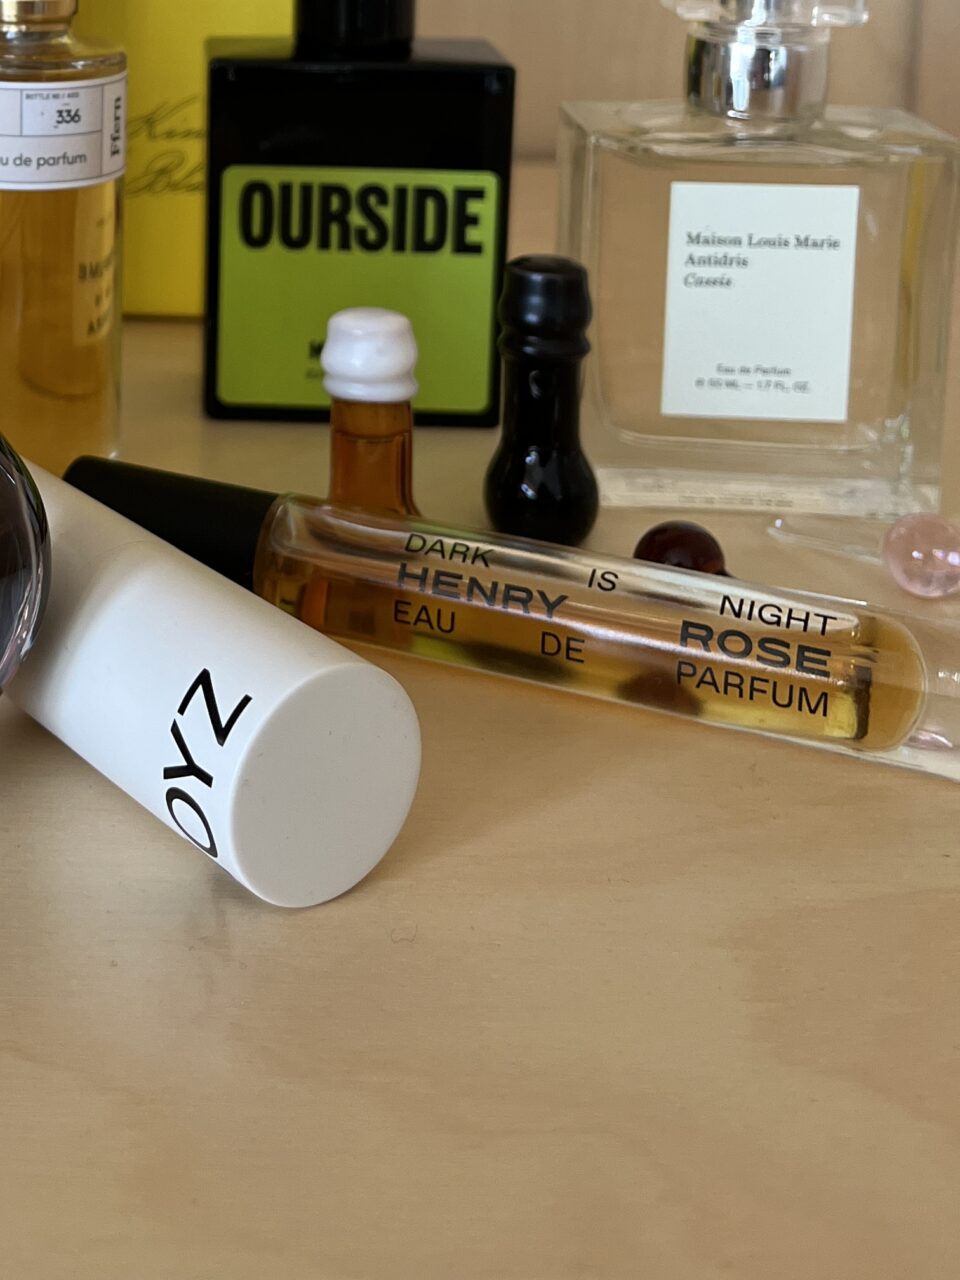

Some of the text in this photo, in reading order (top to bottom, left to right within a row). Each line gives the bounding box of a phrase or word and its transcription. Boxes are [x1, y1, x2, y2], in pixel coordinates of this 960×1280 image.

[55, 108, 81, 125] 336
[13, 152, 33, 167] de
[36, 151, 88, 170] parfum
[239, 179, 487, 256] OURSIDE
[686, 231, 743, 247] Maison
[794, 234, 841, 250] Marie
[396, 562, 833, 678] HENRY ROSE
[404, 532, 838, 637] DARK IS NIGHT
[393, 599, 830, 718] EAU DE PARFUM
